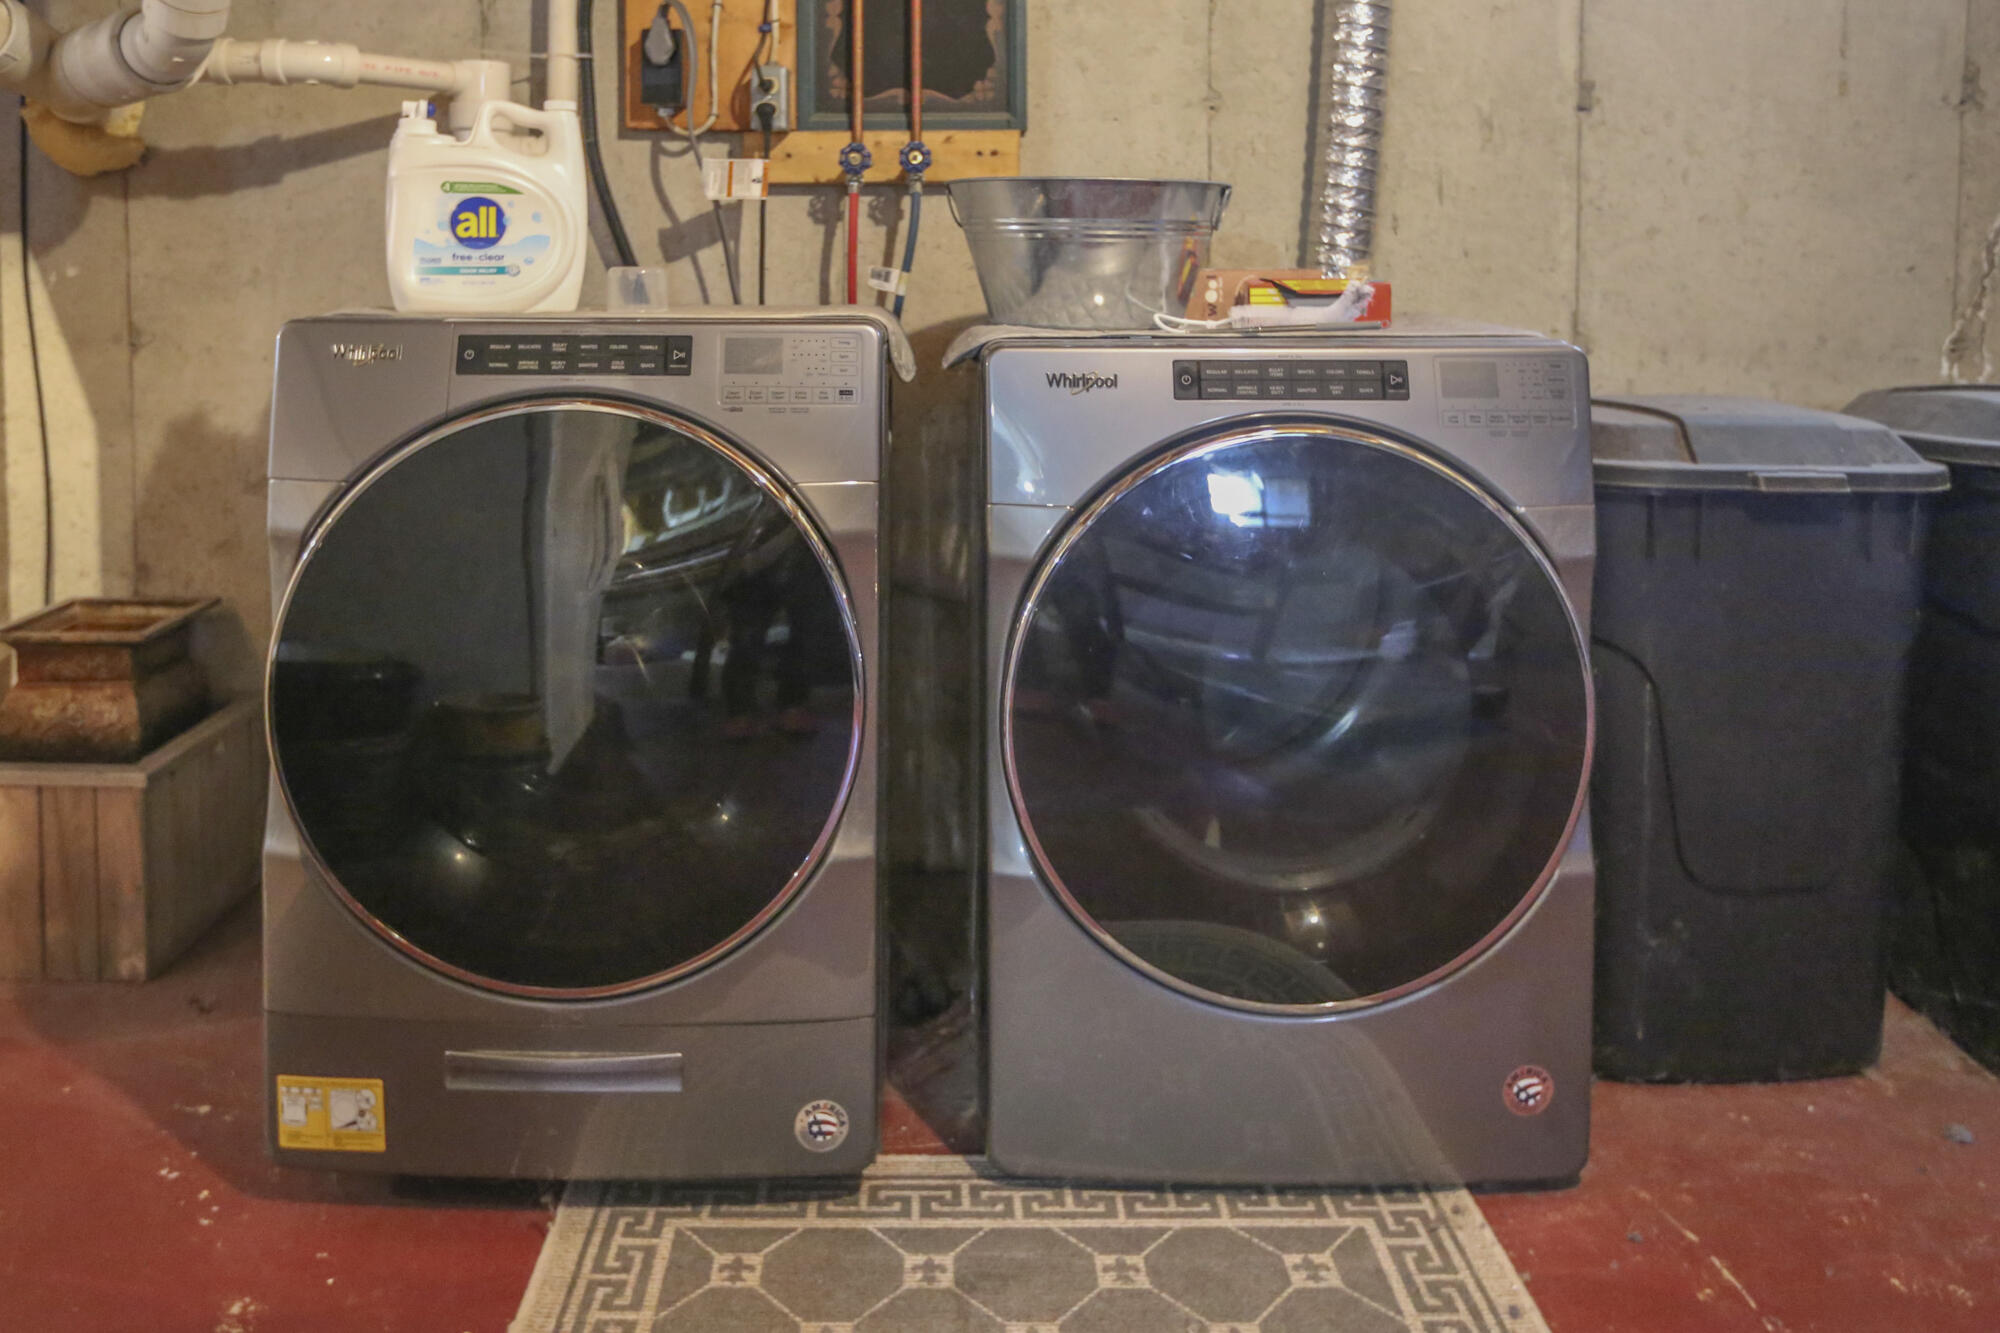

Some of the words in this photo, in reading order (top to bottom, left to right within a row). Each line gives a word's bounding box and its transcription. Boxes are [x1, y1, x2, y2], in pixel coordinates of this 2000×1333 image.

[456, 206, 498, 238] all
[452, 253, 473, 262] free
[478, 253, 505, 262] clear
[330, 344, 403, 365] Whirlpool
[1046, 372, 1118, 393] Whirlpool
[804, 1102, 847, 1127] AMERICA
